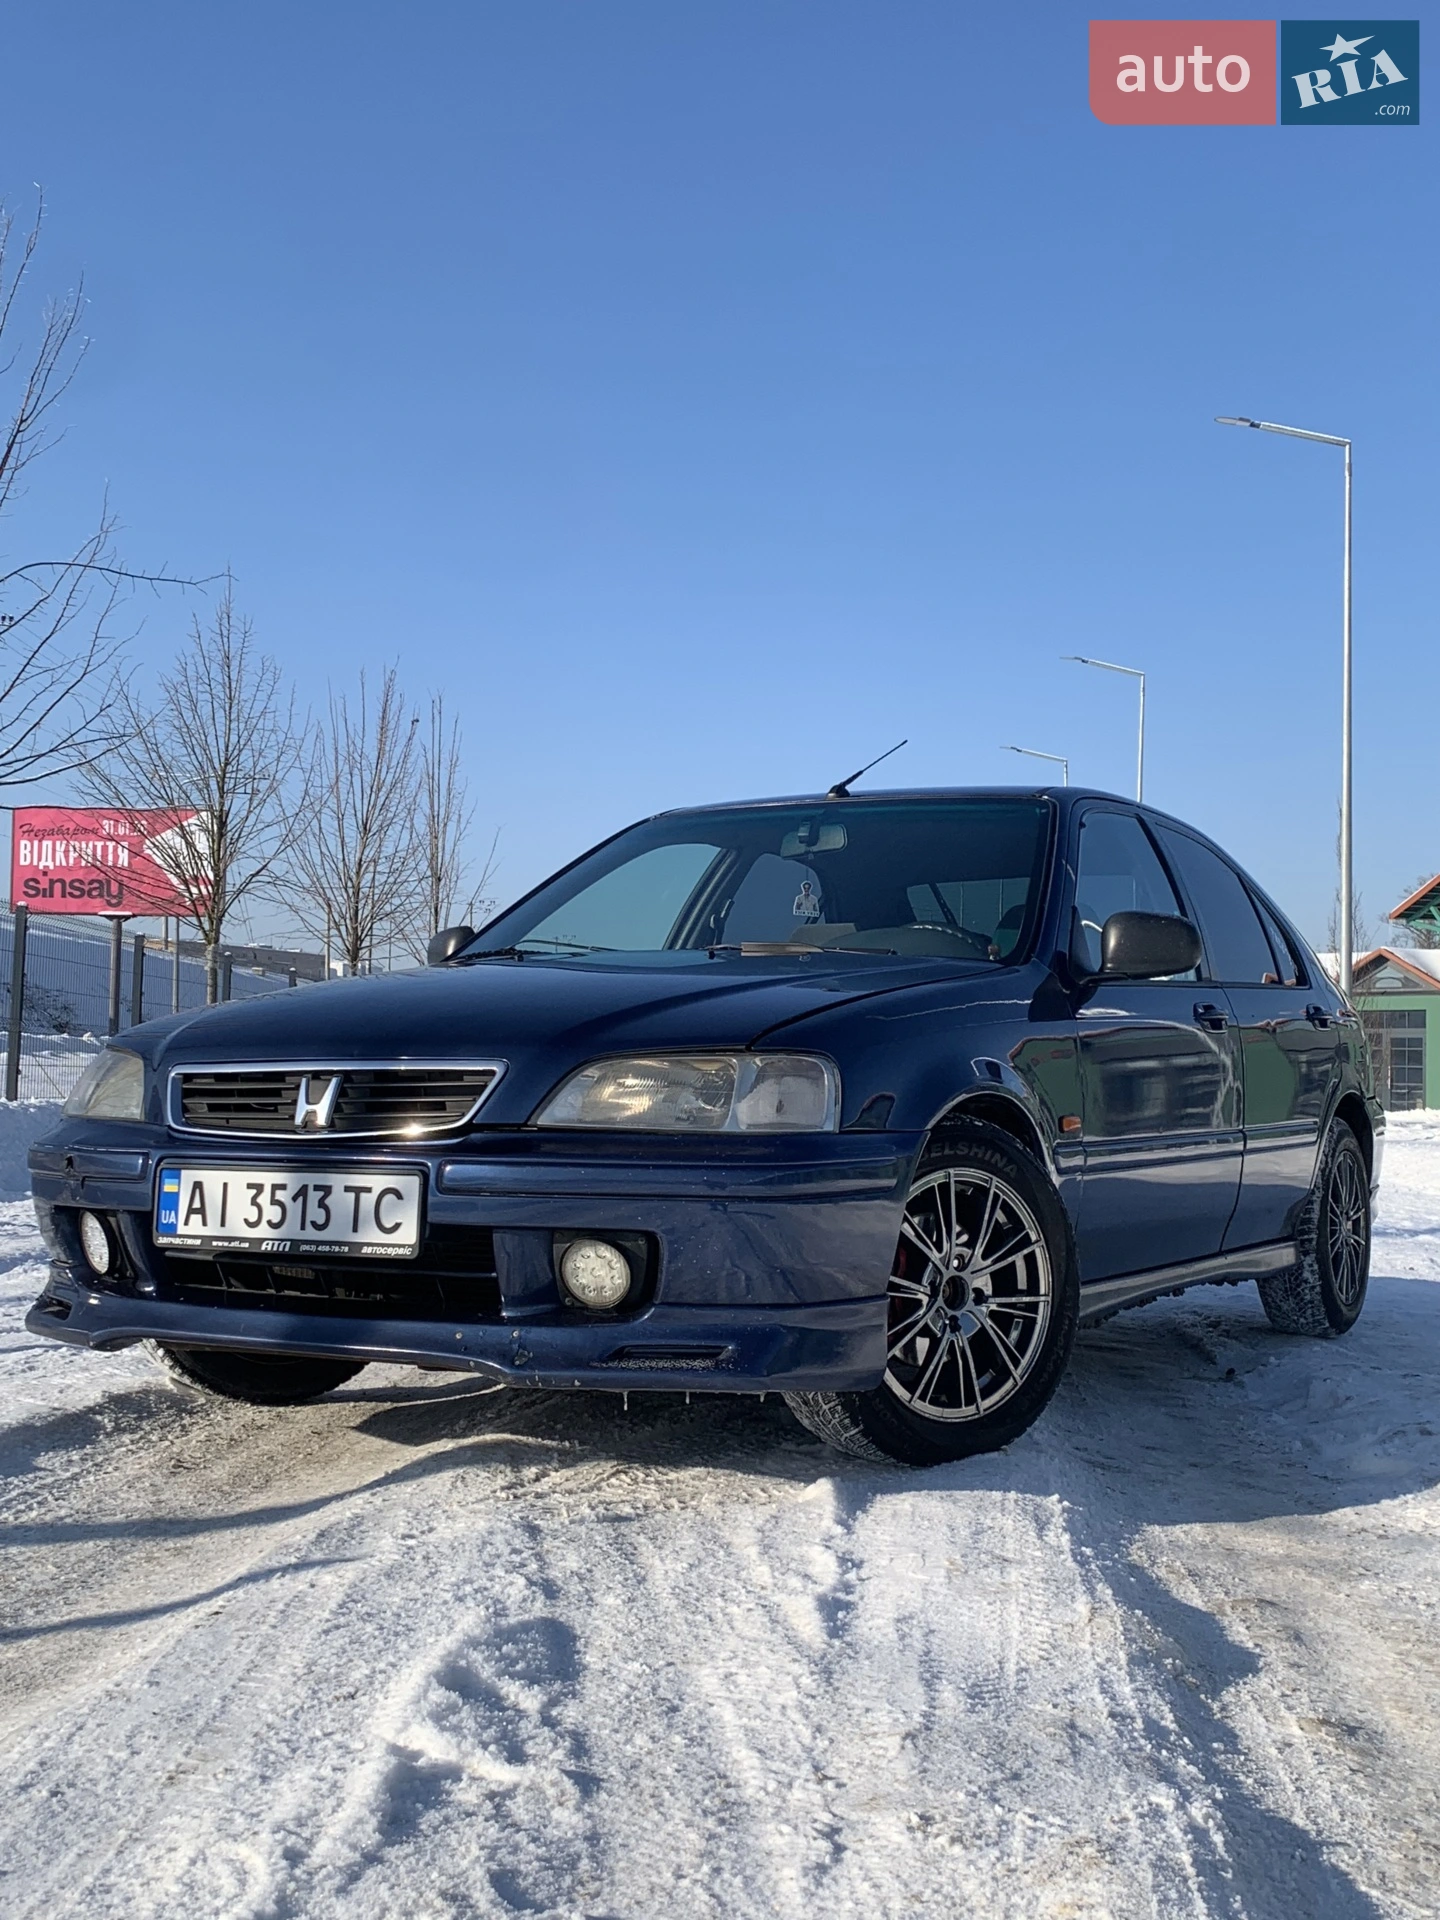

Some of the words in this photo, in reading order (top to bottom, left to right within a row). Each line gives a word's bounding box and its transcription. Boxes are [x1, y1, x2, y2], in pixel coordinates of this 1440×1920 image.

[19, 840, 129, 869] ВІДКРИТТЯ
[23, 871, 124, 907] sinsay
[161, 1210, 177, 1224] UA
[183, 1180, 229, 1228] AI
[243, 1182, 333, 1231] 3513
[344, 1185, 404, 1234] TC
